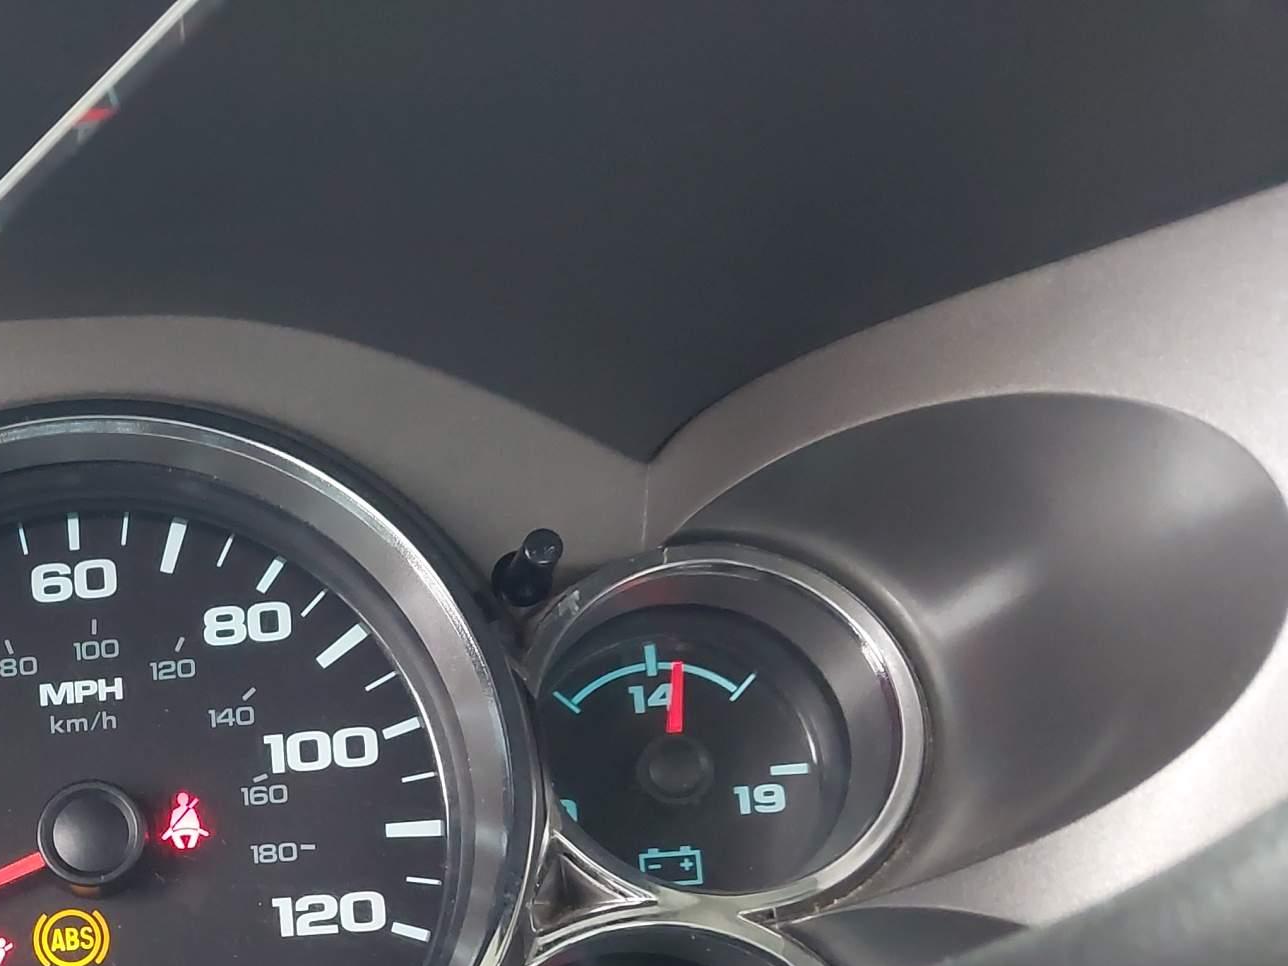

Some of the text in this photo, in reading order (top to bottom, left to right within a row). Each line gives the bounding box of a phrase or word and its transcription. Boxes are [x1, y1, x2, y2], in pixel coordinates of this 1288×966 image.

[32, 559, 117, 602] 60
[204, 602, 291, 645] 80
[74, 640, 119, 660] 100
[0, 657, 37, 677] 80
[150, 659, 195, 680] 120
[40, 678, 123, 706] MPH
[50, 712, 116, 733] km/h
[209, 707, 254, 727] 140
[264, 727, 378, 773] 100
[241, 785, 287, 805] 160
[734, 784, 785, 814] 19
[251, 843, 297, 863] 180
[272, 892, 385, 937] 120
[50, 926, 93, 951] ABS
